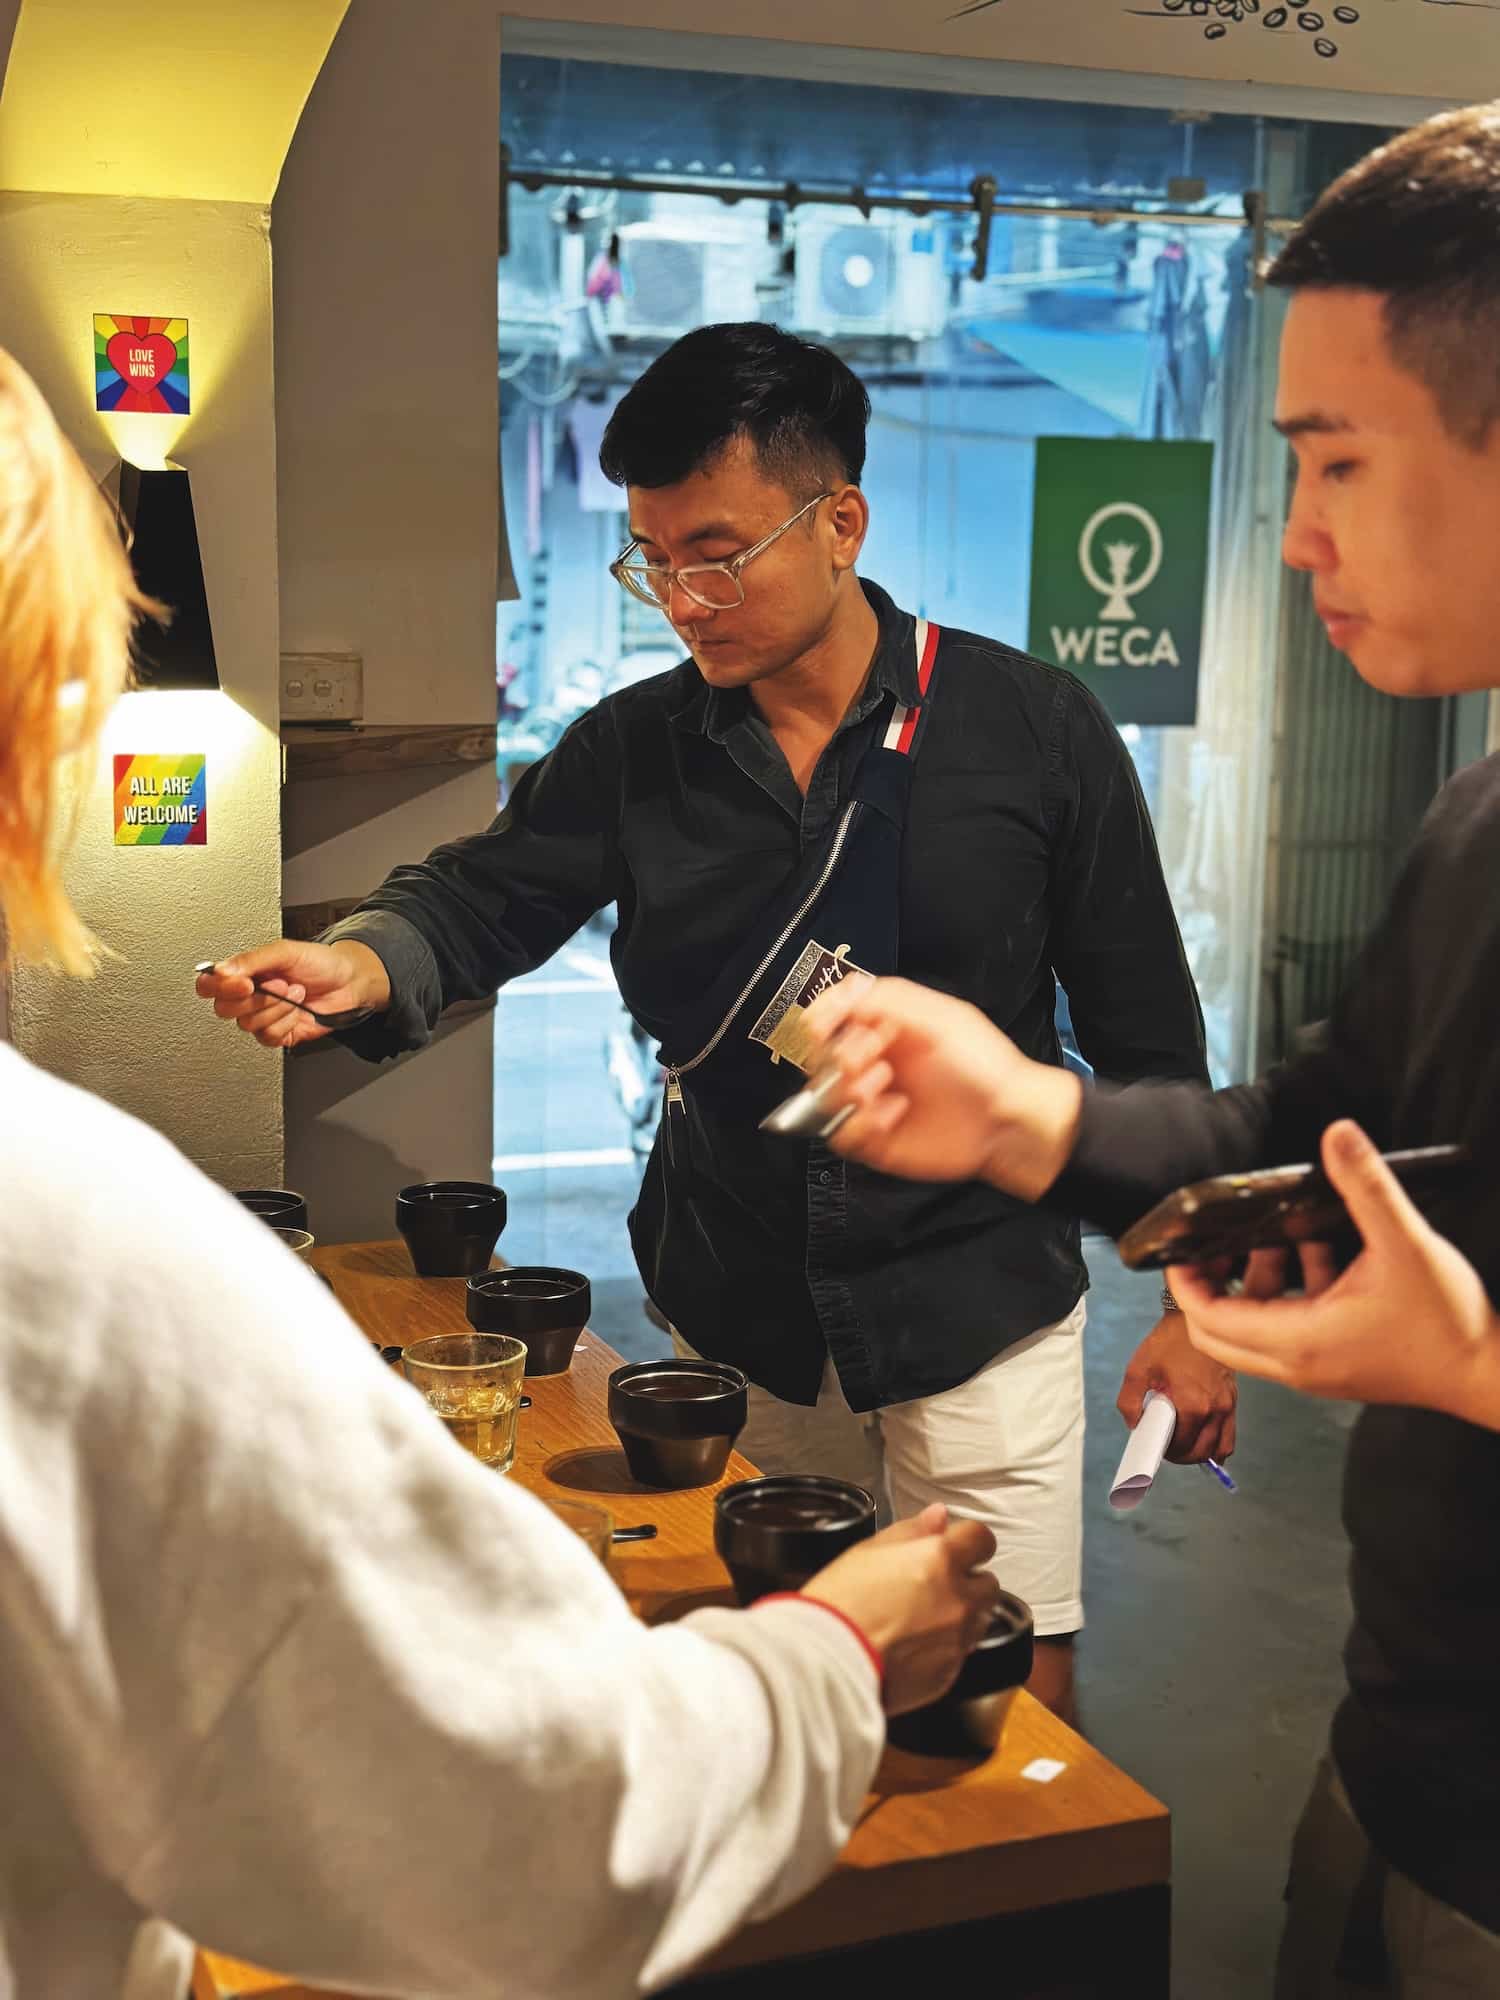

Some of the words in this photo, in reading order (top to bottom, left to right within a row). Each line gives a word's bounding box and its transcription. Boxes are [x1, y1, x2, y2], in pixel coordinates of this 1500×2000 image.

[129, 349, 154, 363] LOVE
[129, 363, 155, 378] WINS
[1050, 626, 1180, 667] WECA
[131, 776, 159, 796] ALL
[163, 776, 192, 796] ARE
[124, 804, 198, 825] WELCOME
